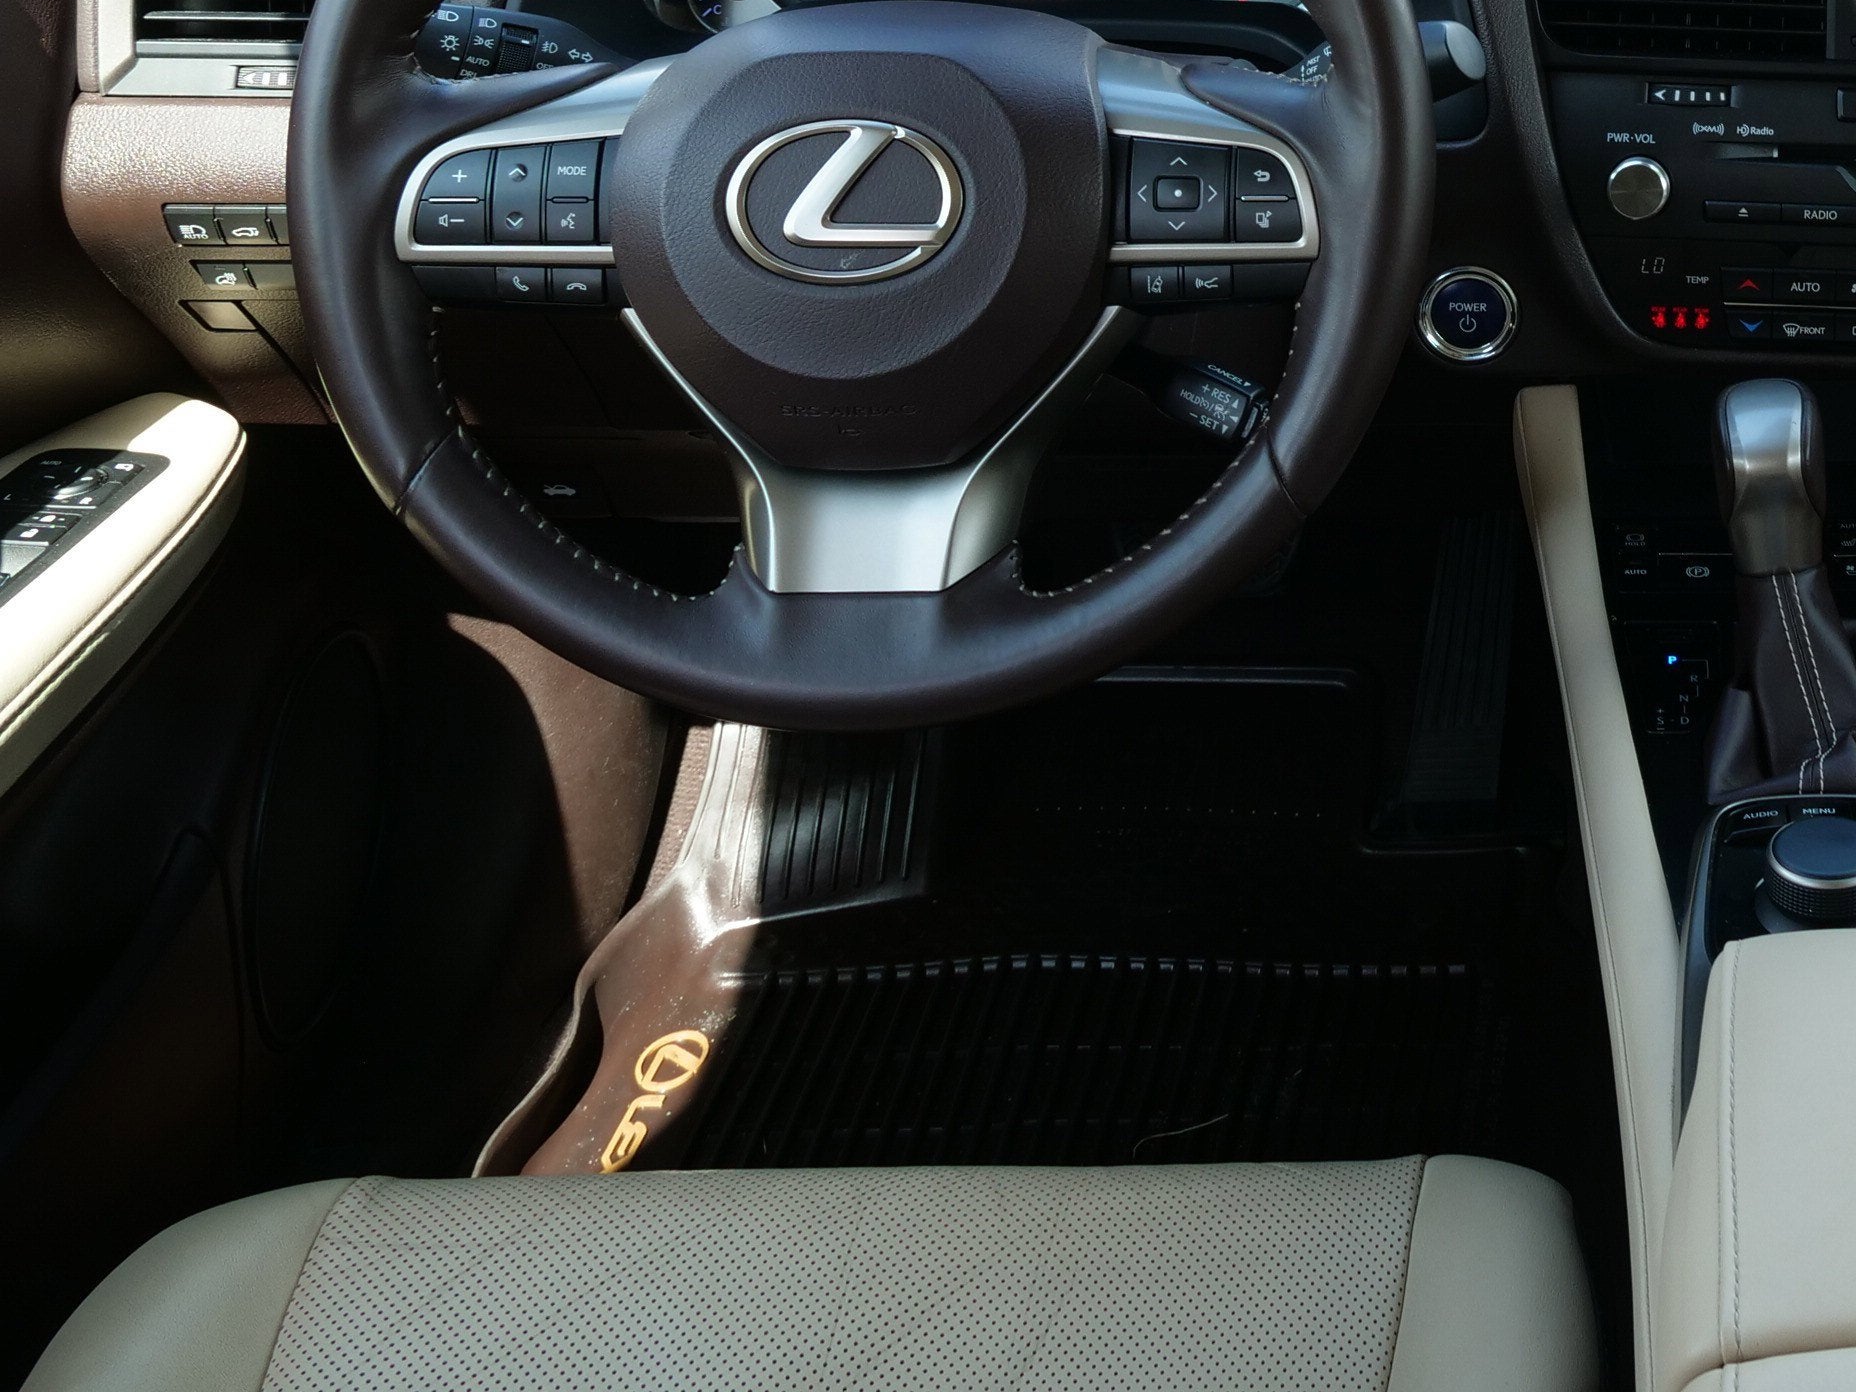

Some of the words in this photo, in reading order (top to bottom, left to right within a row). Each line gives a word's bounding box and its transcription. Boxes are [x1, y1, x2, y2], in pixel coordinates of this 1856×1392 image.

[713, 4, 722, 15] C
[466, 56, 490, 67] AUTO
[1306, 65, 1318, 75] OFF
[1751, 126, 1774, 136] Radio
[557, 166, 587, 176] MODE
[1803, 209, 1838, 221] RADIO
[1686, 275, 1709, 284] TEMP
[1790, 282, 1821, 292] AUTO
[1449, 302, 1487, 312] POWER
[1800, 326, 1825, 335] FRONT
[1207, 364, 1243, 385] CANCEL
[1180, 389, 1200, 405] HOLD
[1211, 388, 1231, 404] RES
[1199, 415, 1219, 430] SET
[1668, 655, 1677, 664] P
[1679, 694, 1689, 702] N
[1743, 810, 1779, 820] AUDIO
